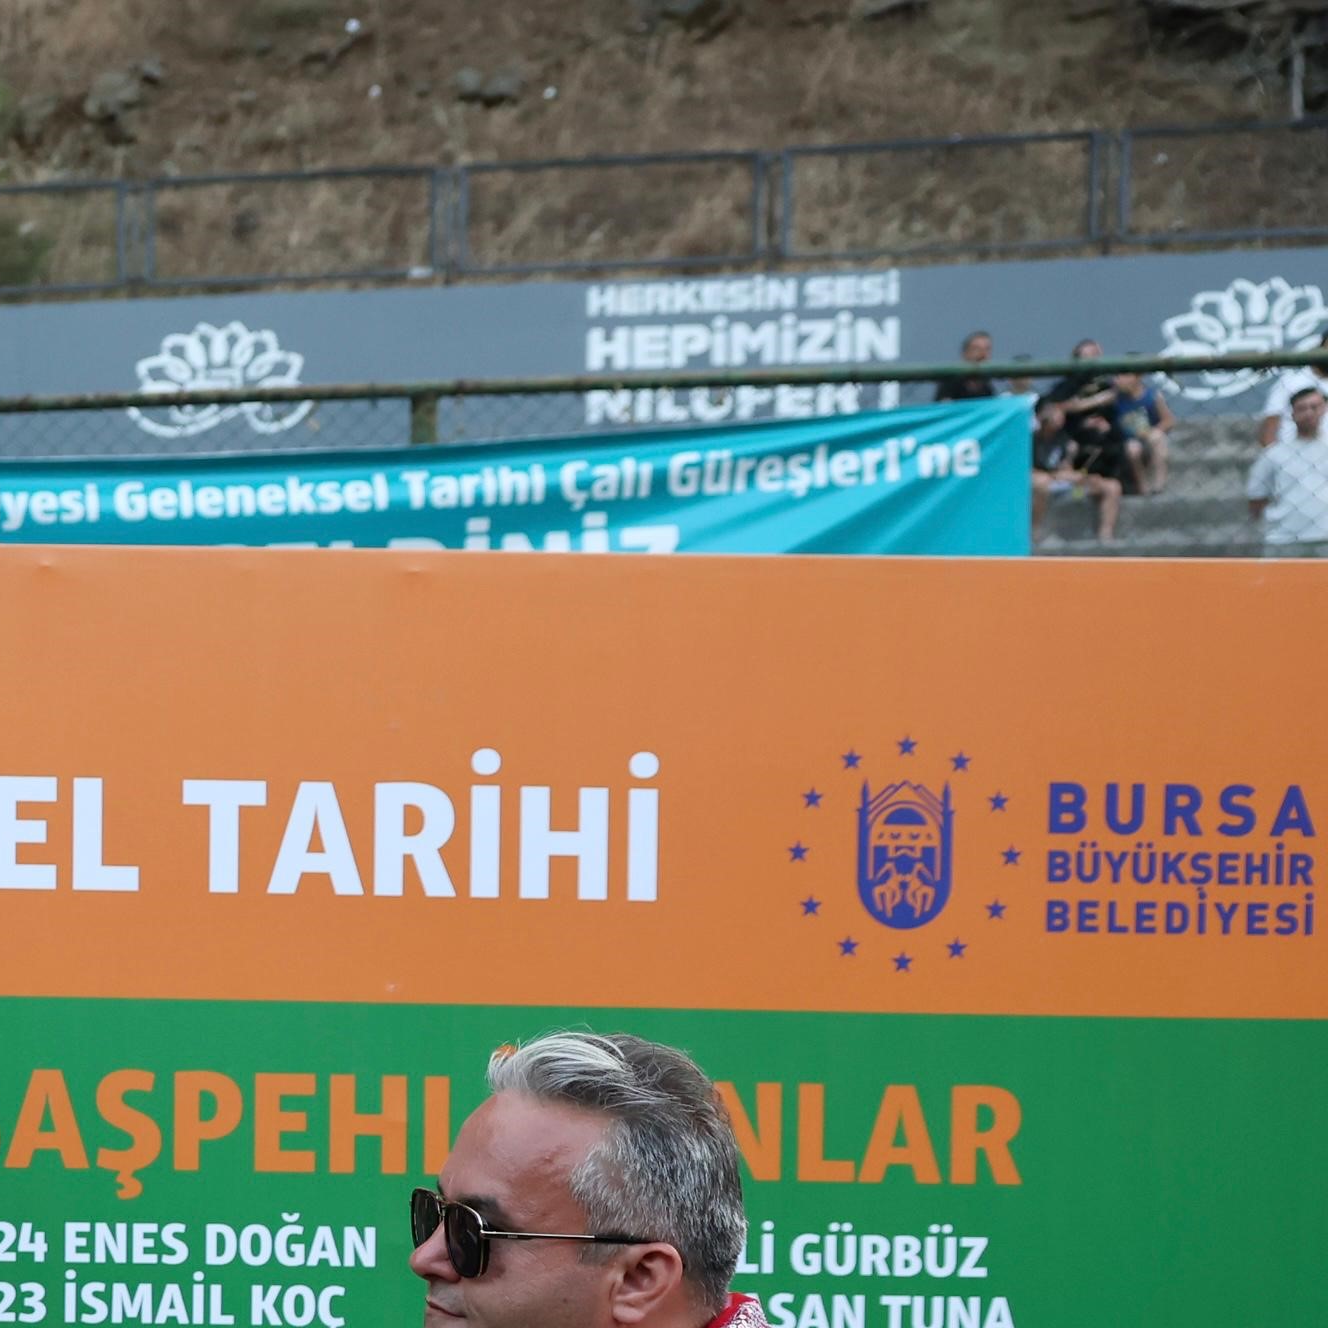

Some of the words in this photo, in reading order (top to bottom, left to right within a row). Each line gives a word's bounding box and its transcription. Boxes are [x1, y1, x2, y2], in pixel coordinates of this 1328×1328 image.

[113, 473, 389, 522] Geleneksel
[402, 463, 544, 510] Tarihi
[559, 456, 653, 511] Çalı
[667, 437, 982, 497] Güreşleri'ne
[182, 747, 660, 902] TARİHİ
[1047, 781, 1316, 837] BURSA
[1046, 841, 1314, 891] BÜYÜKŞEHİR
[1046, 891, 1314, 936] BELEDİYESİ
[64, 1221, 189, 1265] ENES
[205, 1212, 376, 1268] DOĞAN
[736, 1220, 774, 1275] Lİ
[789, 1221, 989, 1279] GÜRBÜZ
[64, 1269, 235, 1326] İSMAİL
